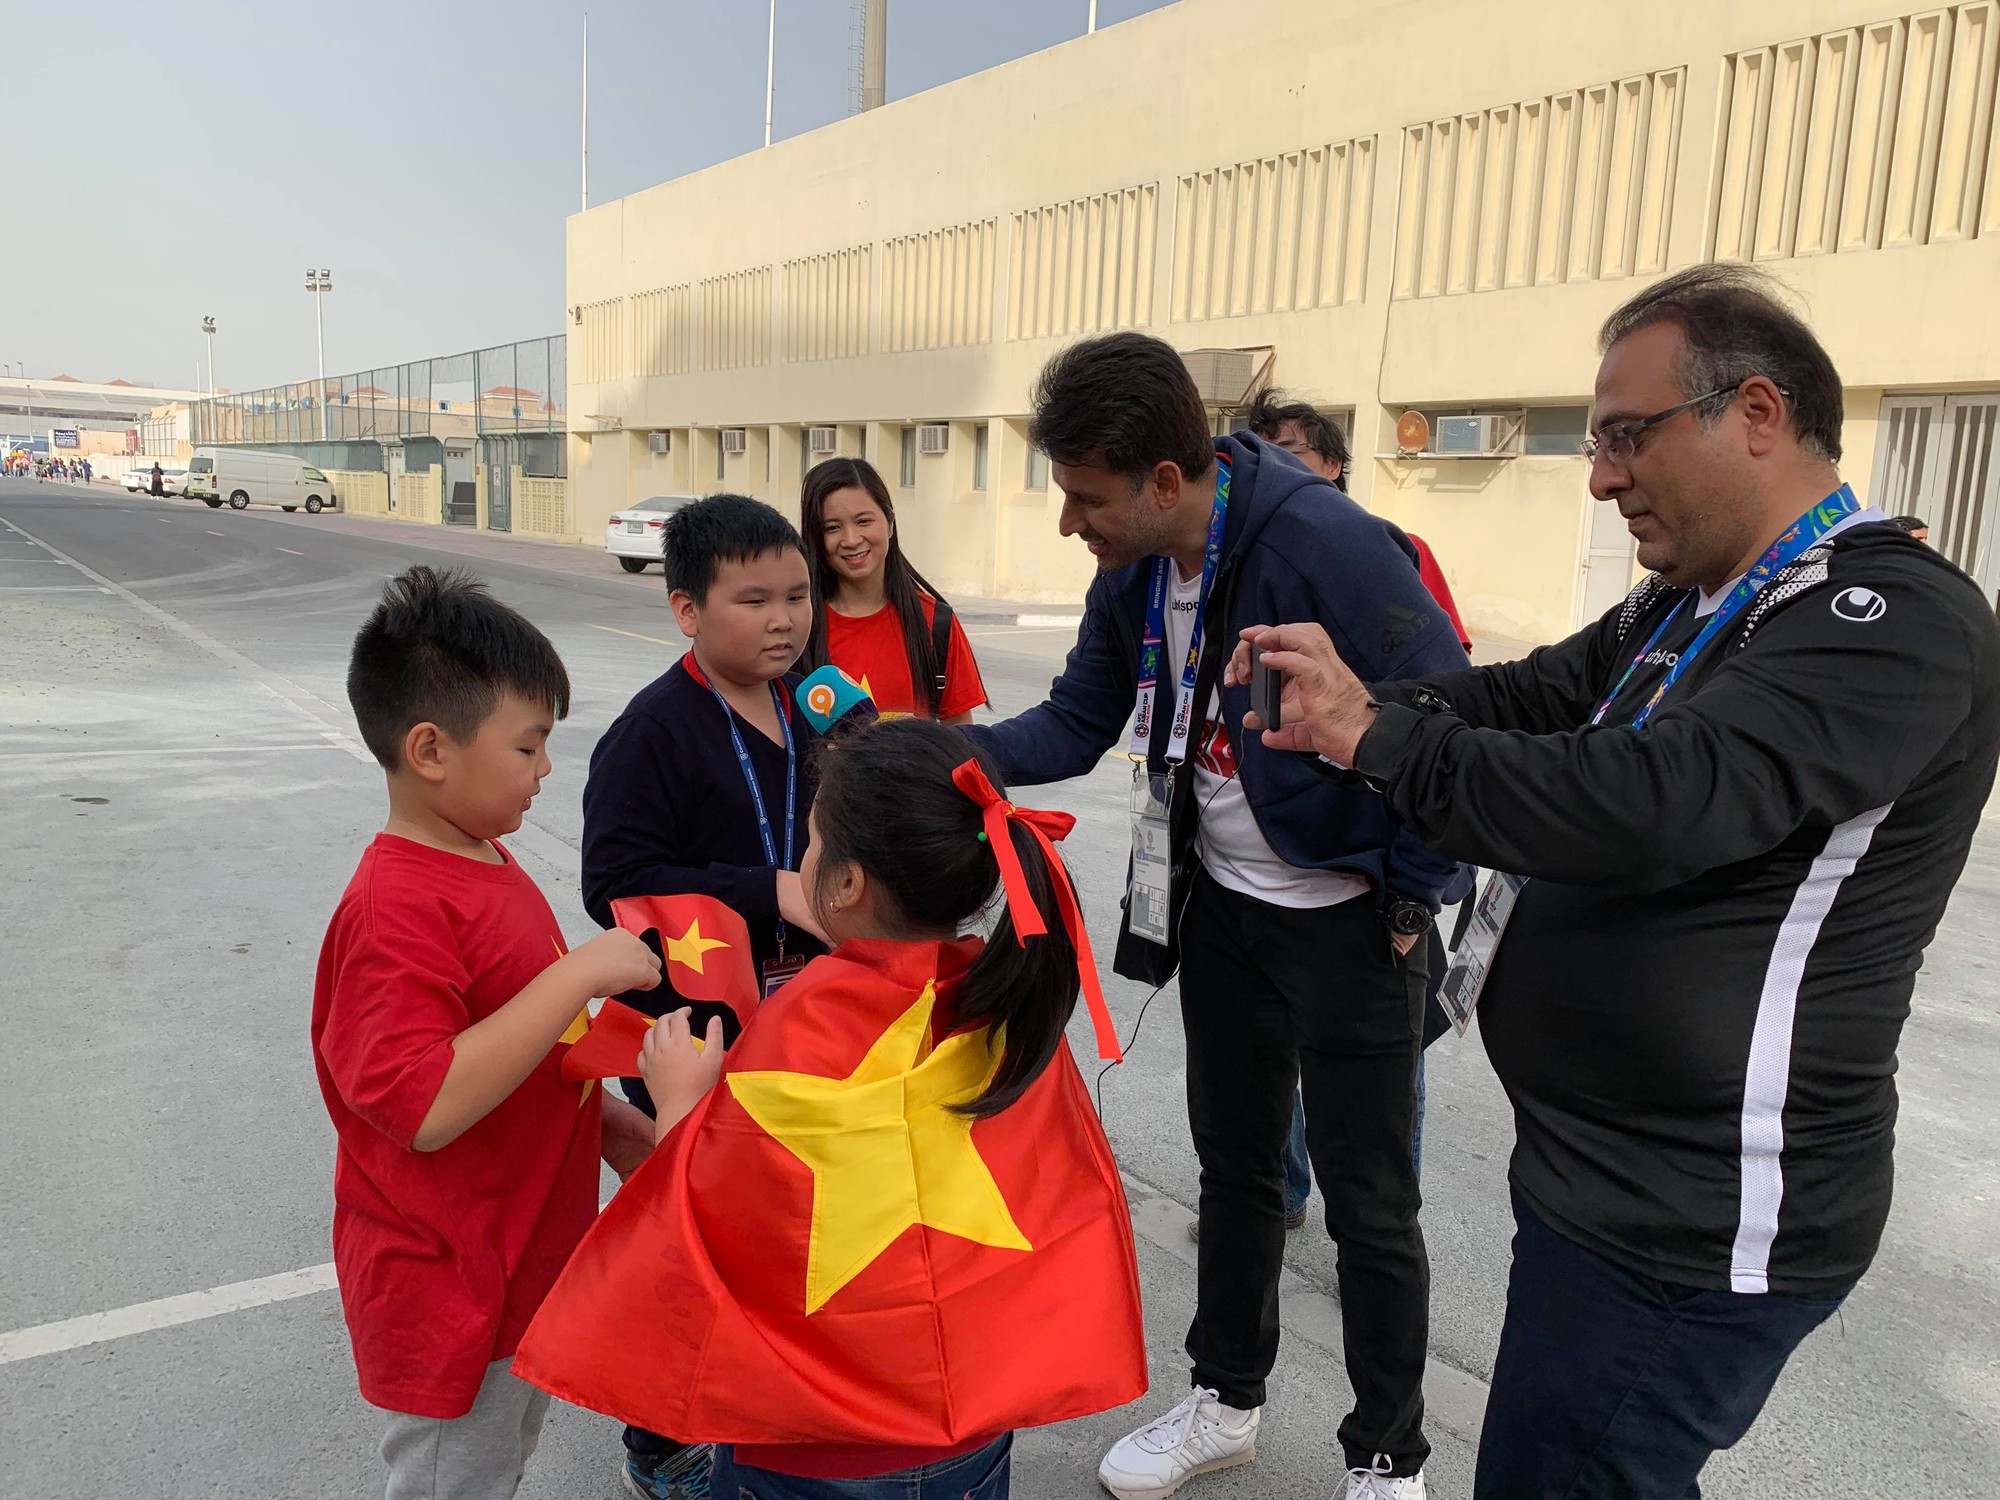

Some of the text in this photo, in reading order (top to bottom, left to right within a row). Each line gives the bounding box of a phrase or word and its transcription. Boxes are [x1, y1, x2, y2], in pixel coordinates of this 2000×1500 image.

[1153, 558, 1165, 609] BRINGING ASIA
[1171, 598, 1199, 614] uhlspo
